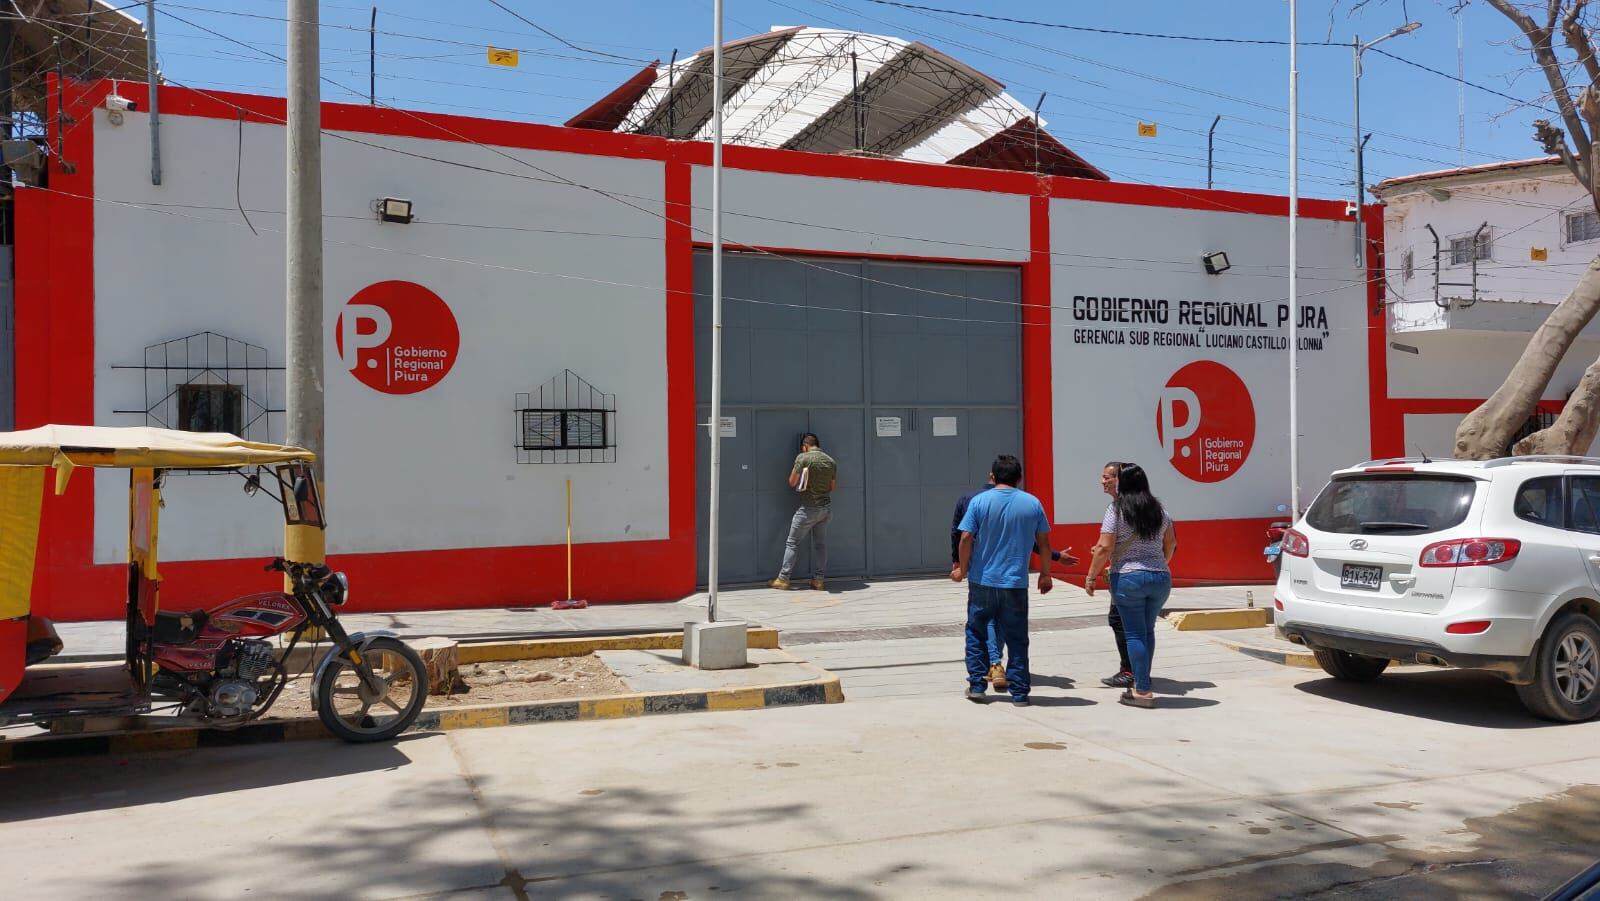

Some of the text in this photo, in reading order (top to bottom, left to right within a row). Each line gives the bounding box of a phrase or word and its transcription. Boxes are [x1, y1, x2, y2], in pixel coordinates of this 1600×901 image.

[1073, 295, 1329, 330] GOBIERNO REGIONAL PURA
[1073, 328, 1125, 346] GERENCIA
[1129, 330, 1150, 346] SUB
[1153, 332, 1202, 348] REGIONAL
[1246, 334, 1287, 350] CASTILLO
[1288, 331, 1330, 351] LONNA”
[394, 346, 448, 358] Gobierno
[394, 358, 444, 371] Regional
[394, 370, 428, 381] Piura
[1205, 438, 1243, 450] Gobierno
[1205, 449, 1242, 462] Regional
[1205, 461, 1229, 472] Piura
[1343, 569, 1378, 585] B1X-526
